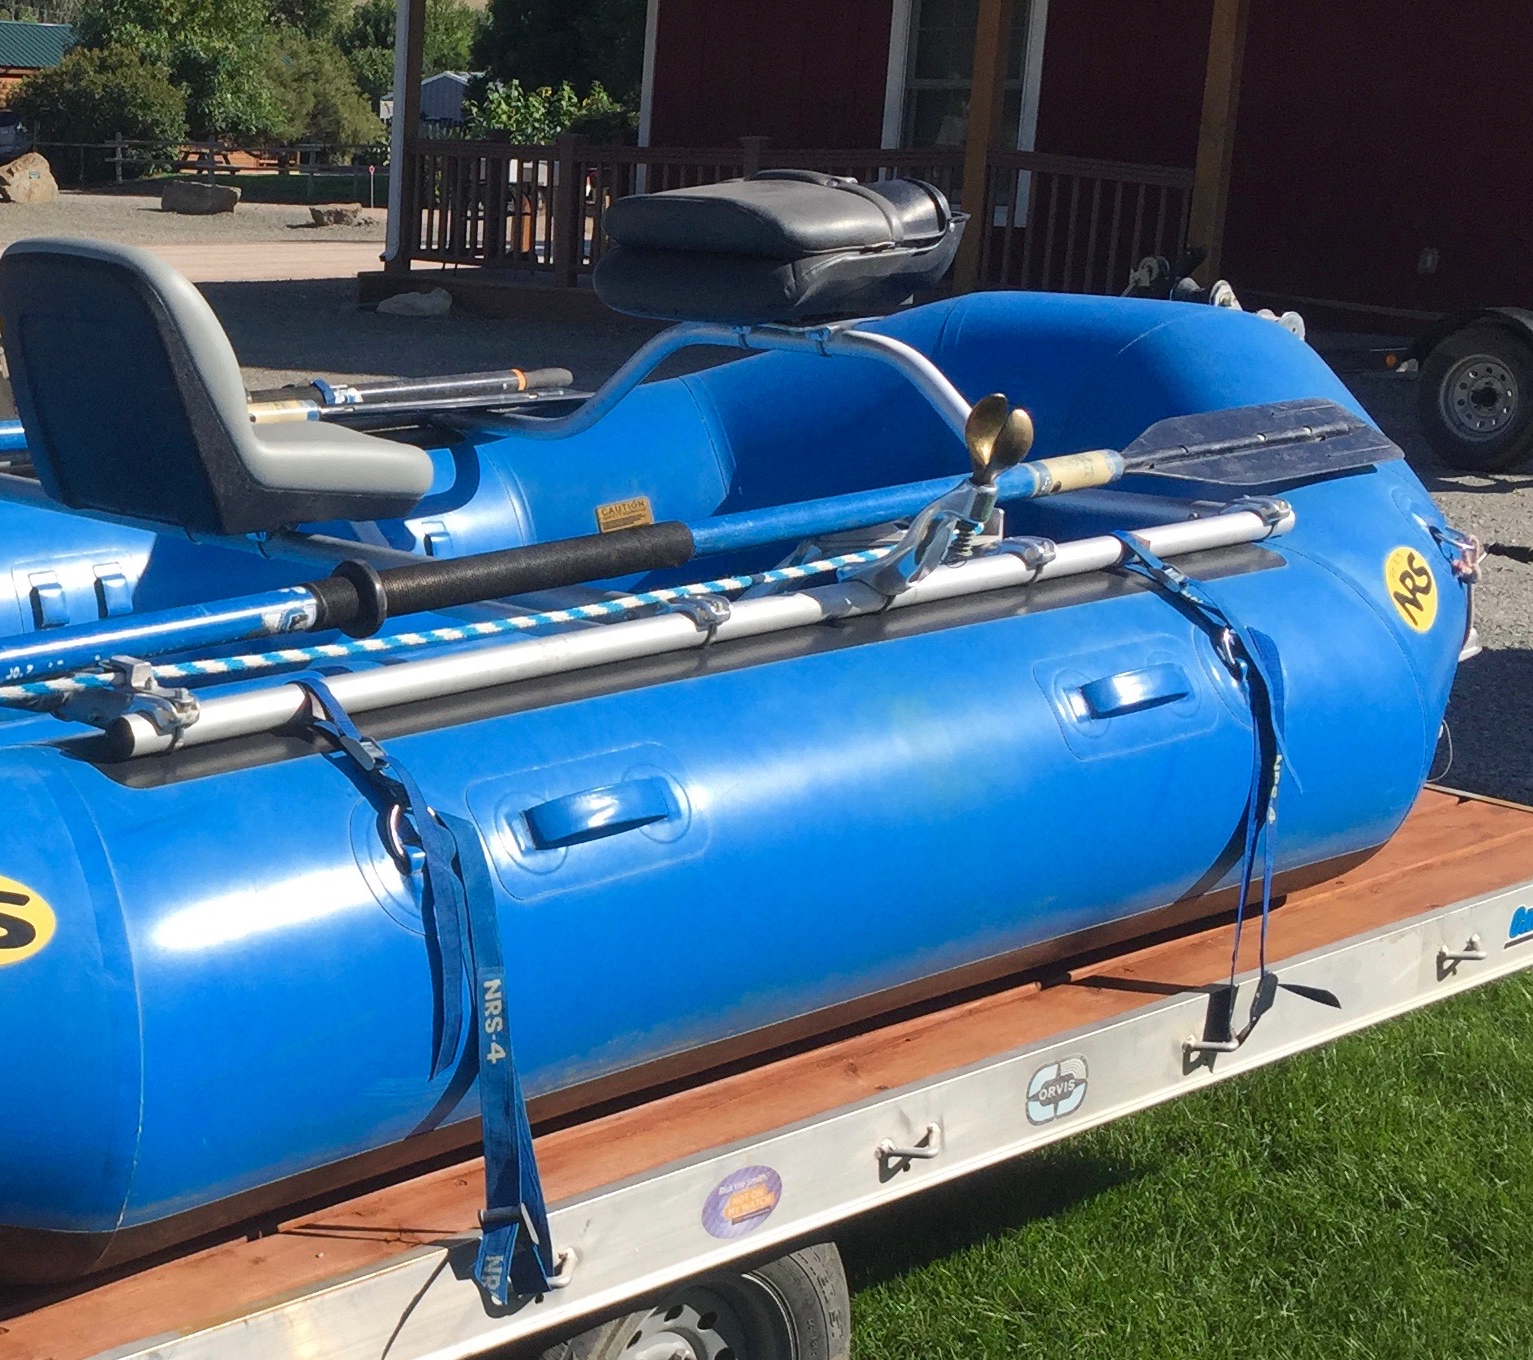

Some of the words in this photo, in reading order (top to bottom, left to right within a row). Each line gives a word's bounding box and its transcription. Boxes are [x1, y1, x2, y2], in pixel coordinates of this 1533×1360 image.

[601, 500, 645, 516] CAUTION
[1393, 552, 1432, 626] NRS
[483, 979, 506, 1064] NRS-4
[1038, 1079, 1075, 1101] ORVIS
